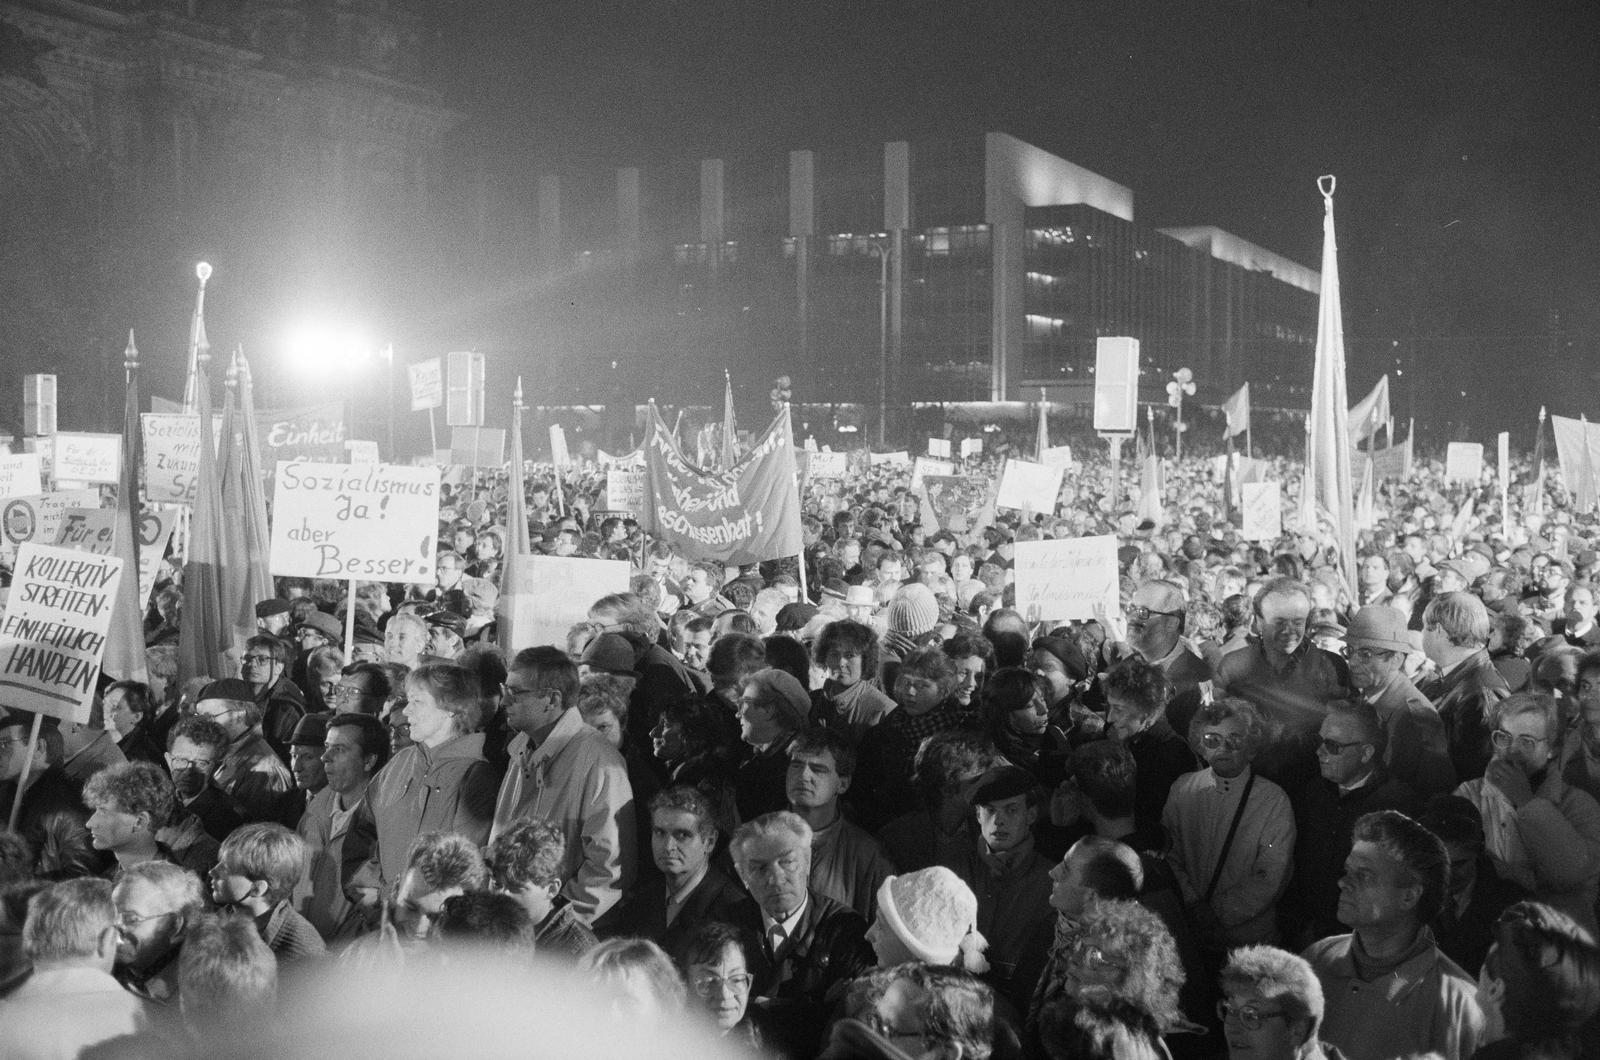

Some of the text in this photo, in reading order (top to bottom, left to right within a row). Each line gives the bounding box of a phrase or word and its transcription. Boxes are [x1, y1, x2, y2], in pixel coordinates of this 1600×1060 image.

[147, 420, 200, 437] Sozialis
[268, 421, 346, 448] Einheit
[156, 453, 200, 474] Zukun
[168, 473, 198, 500] SE
[282, 463, 435, 496] Sozialismus
[40, 497, 65, 509] Trag
[60, 515, 95, 545] Für
[97, 527, 114, 542] ei
[287, 516, 336, 543] aber
[313, 535, 431, 576] Besser!
[25, 555, 119, 588] KOLLEKTIV
[3, 612, 105, 656] EINHEITLICH
[4, 644, 98, 694] HANDELN
